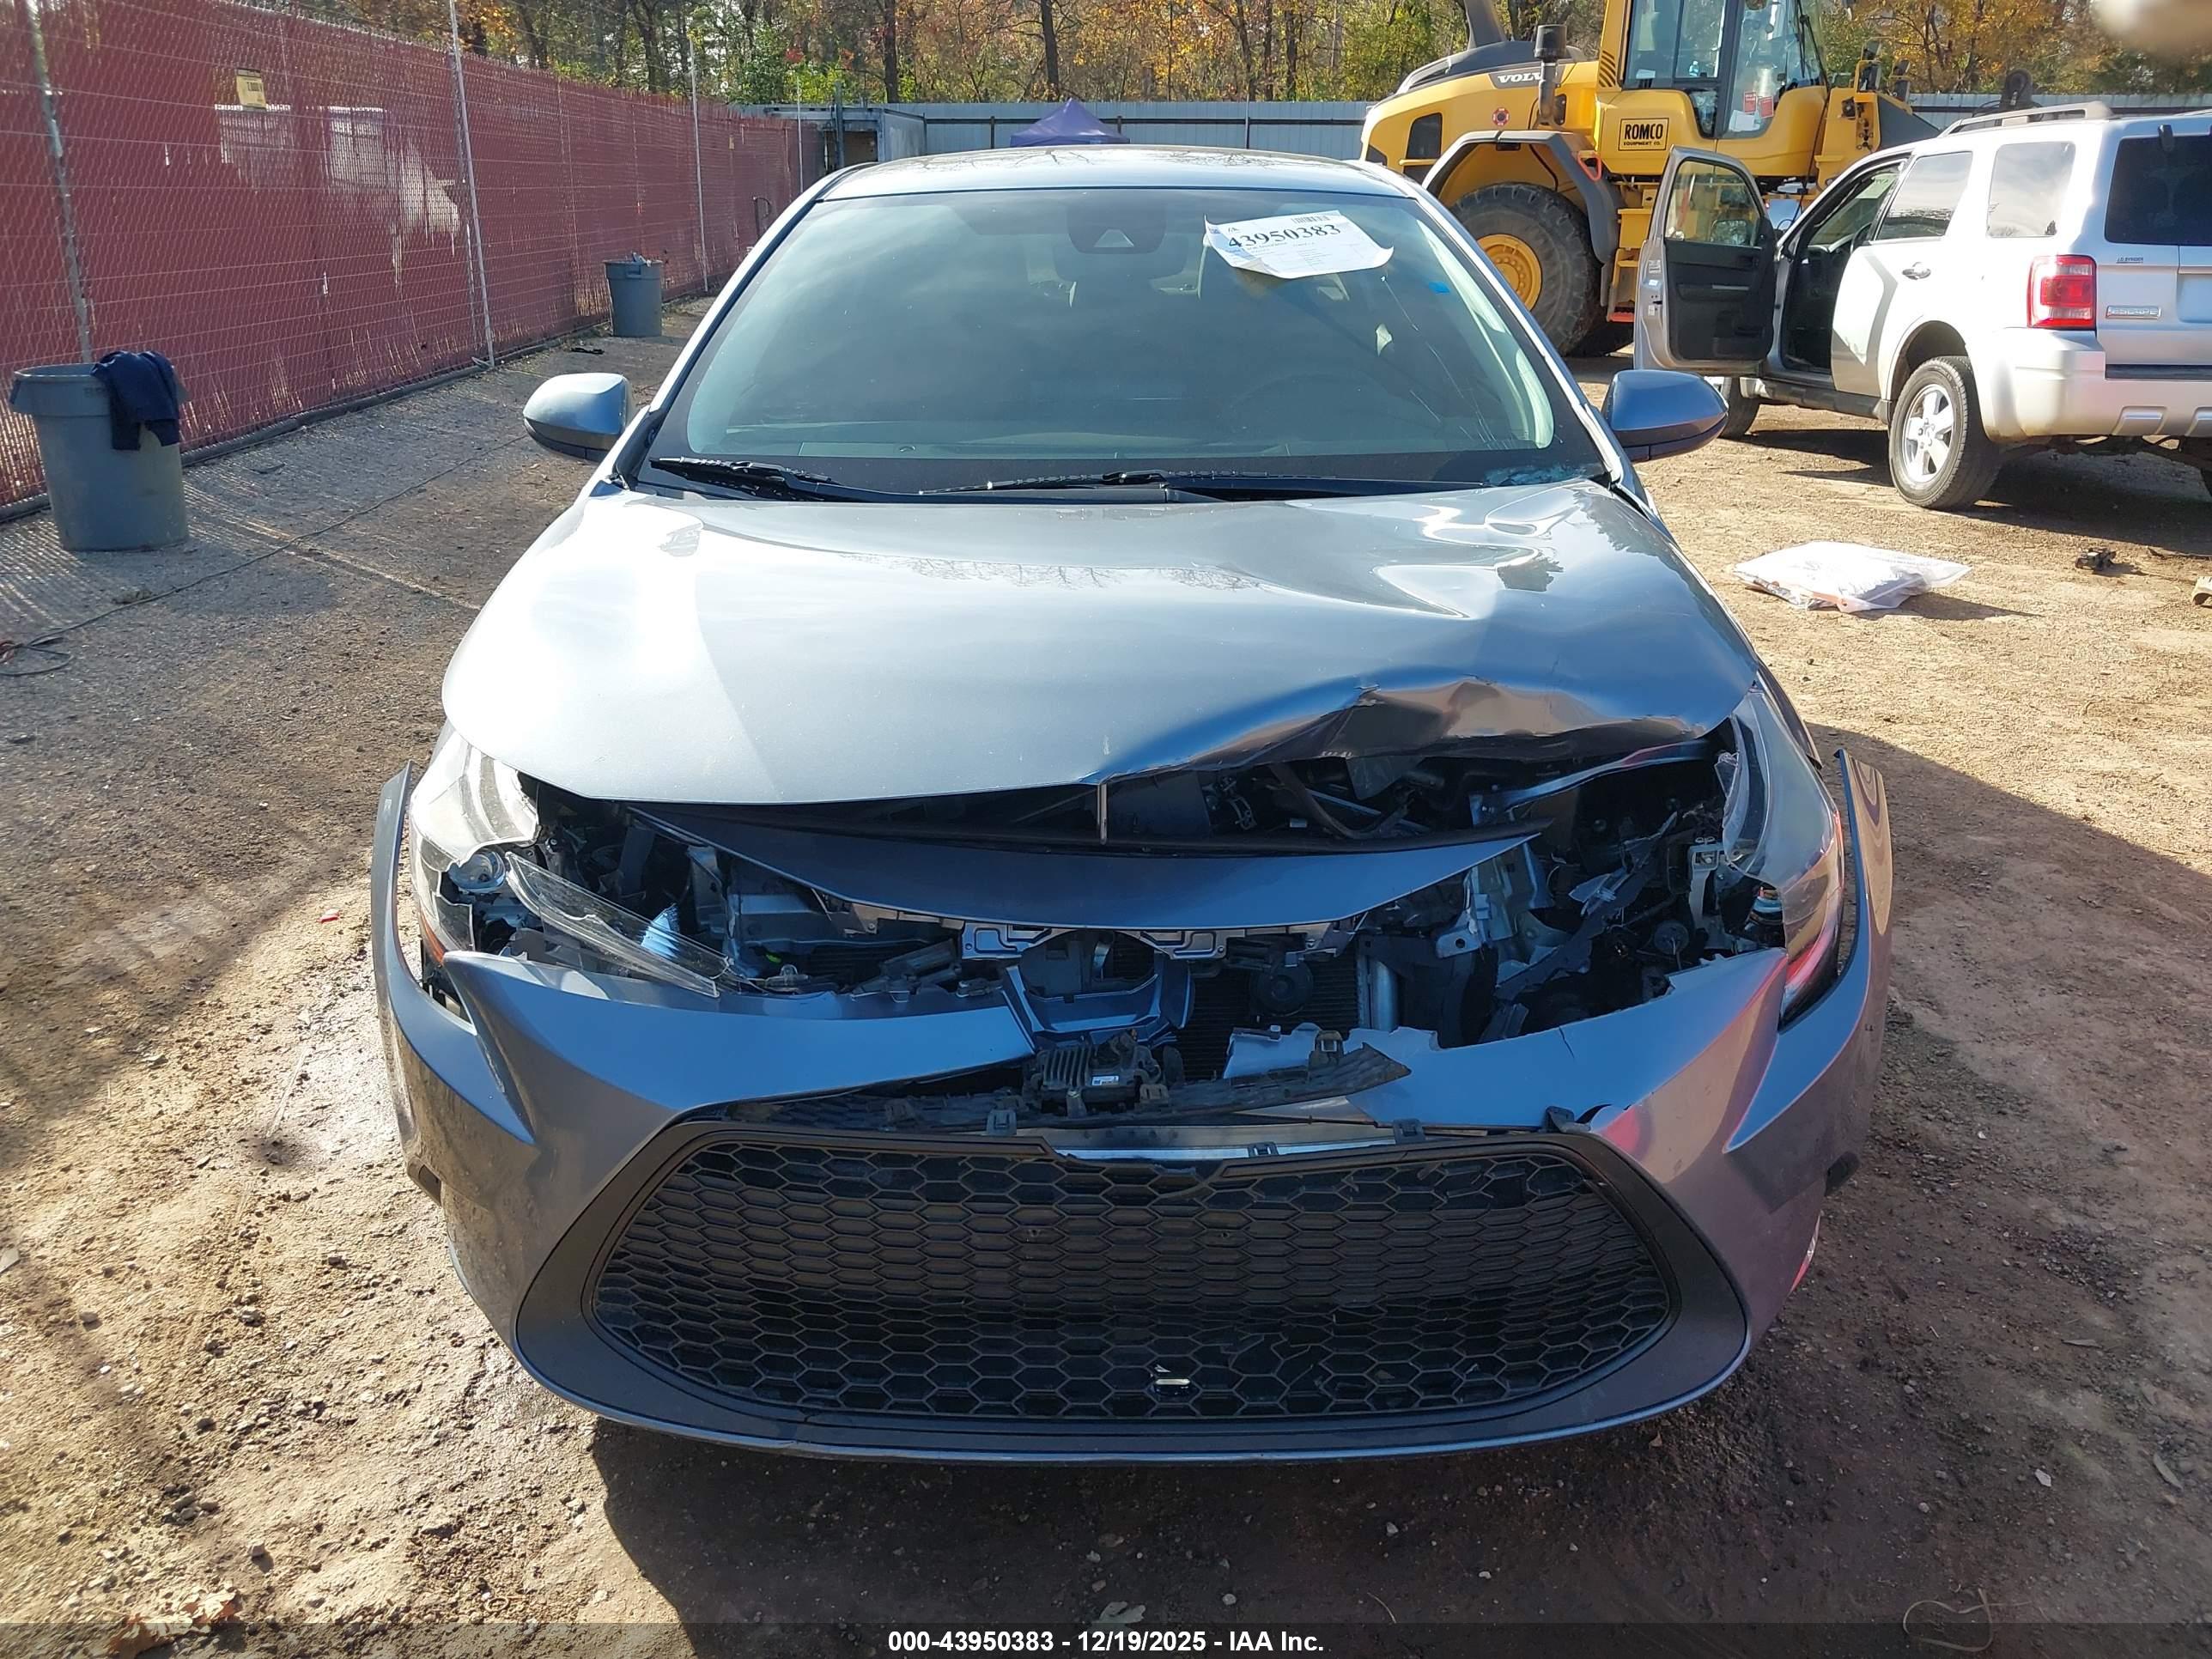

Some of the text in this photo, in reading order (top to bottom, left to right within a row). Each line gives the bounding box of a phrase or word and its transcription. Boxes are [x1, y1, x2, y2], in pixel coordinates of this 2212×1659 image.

[1498, 72, 1542, 83] VOLV
[1624, 124, 1663, 140] ROMCO
[1227, 224, 1341, 247] 43950383
